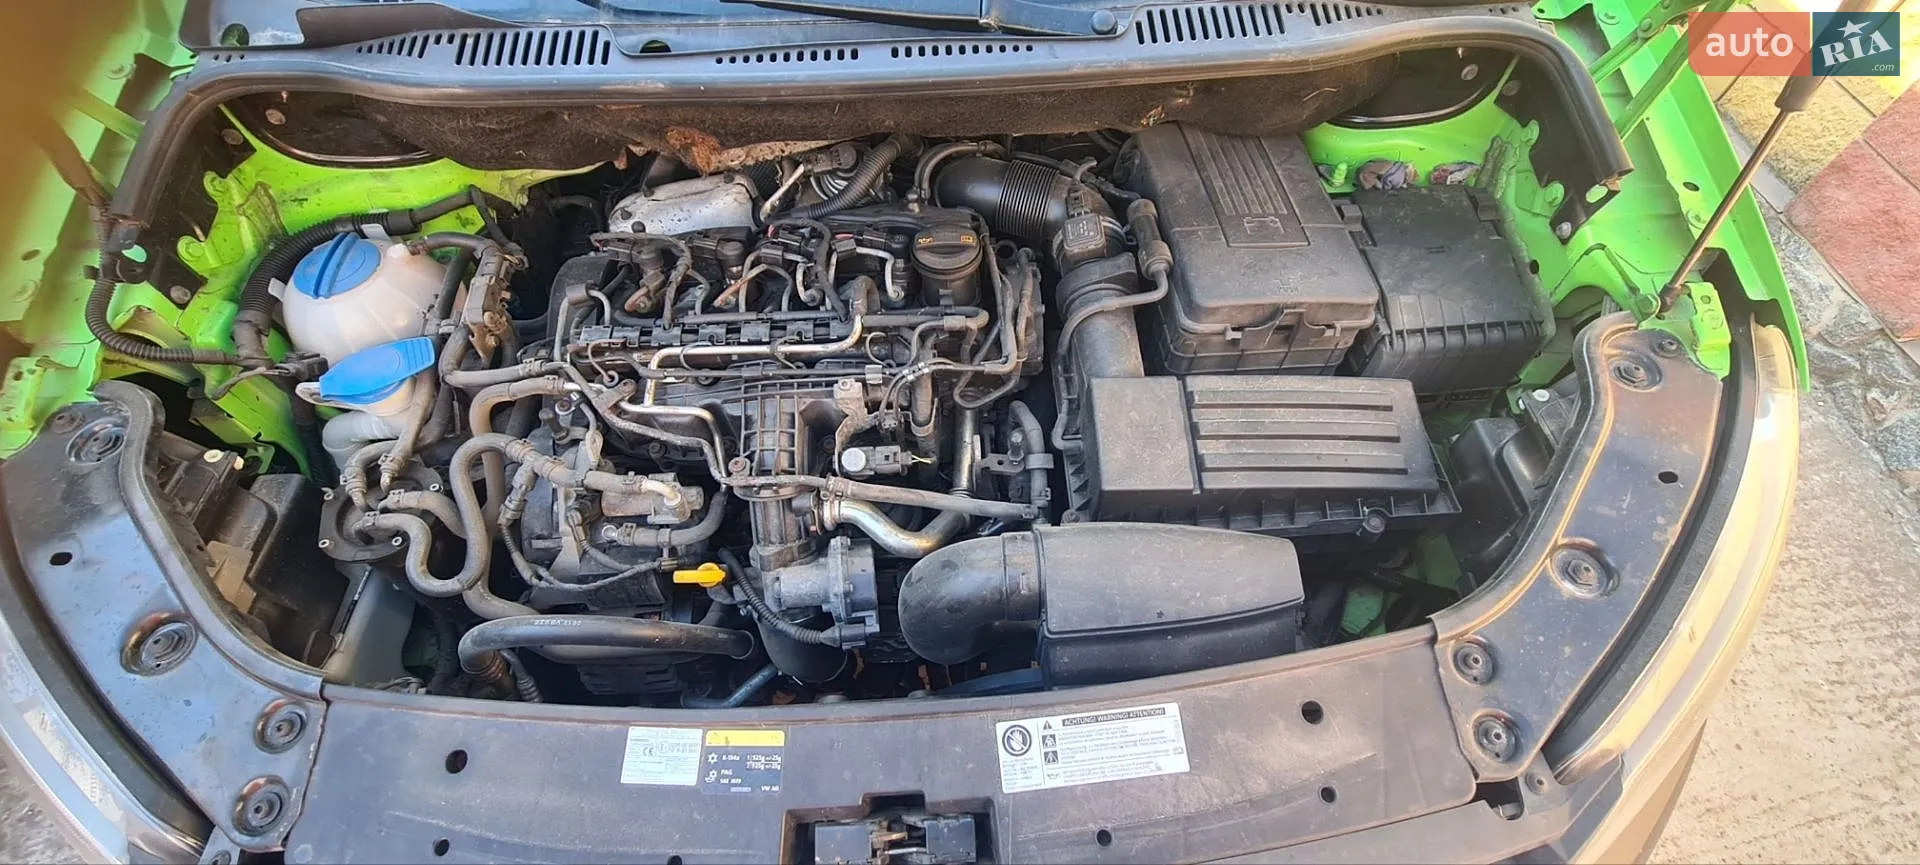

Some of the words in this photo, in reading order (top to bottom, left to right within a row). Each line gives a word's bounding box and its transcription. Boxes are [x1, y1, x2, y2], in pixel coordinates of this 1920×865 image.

[1064, 717, 1097, 726] ACHTUNG!
[1097, 713, 1129, 722] WARNING!
[1128, 707, 1165, 718] ATTENTION!
